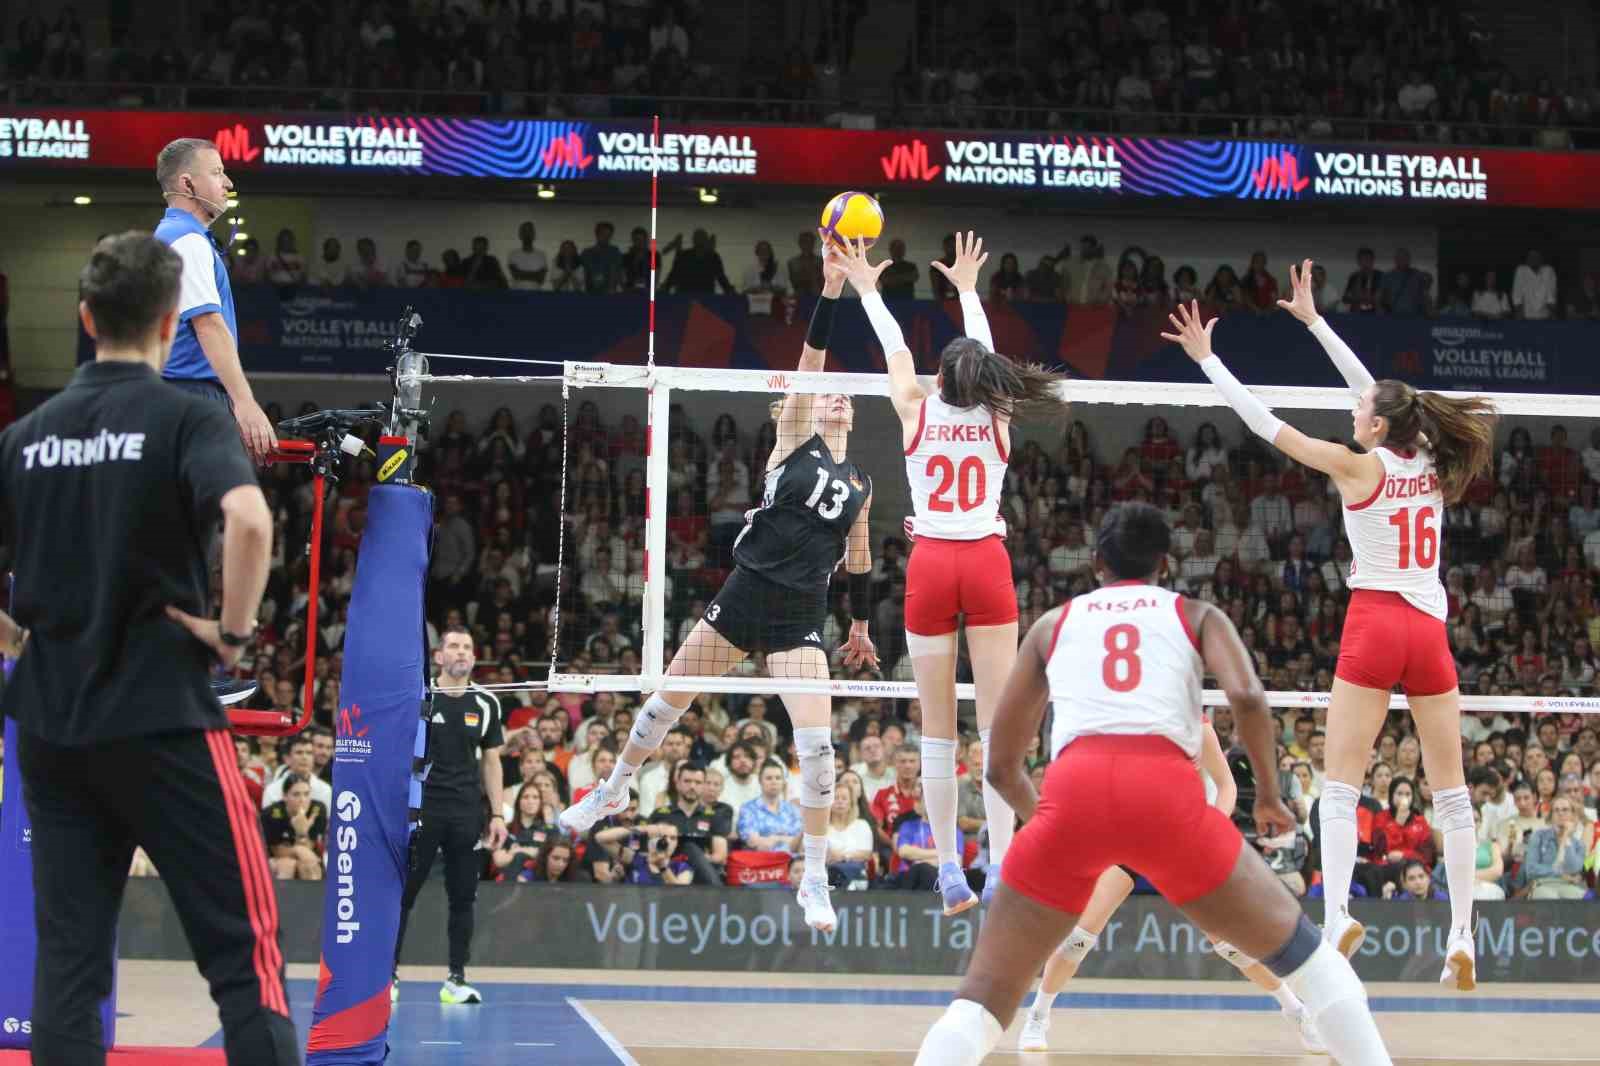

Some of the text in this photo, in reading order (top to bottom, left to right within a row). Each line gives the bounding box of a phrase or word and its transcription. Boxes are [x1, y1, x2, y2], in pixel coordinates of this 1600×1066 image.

[264, 124, 423, 149] VOLLEYBALL
[598, 132, 757, 157] VOLLEYBALL
[17, 142, 90, 159] LEAGUE
[264, 148, 423, 166] NATIONS LEAGUE
[881, 139, 941, 181] VNL
[945, 141, 1121, 168] VOLLEYBALL
[598, 156, 757, 174] NATIONS LEAGUE
[945, 166, 1121, 188] NATIONS LEAGUE
[1252, 151, 1309, 192] VNL
[1315, 152, 1487, 180] VOLLEYBALL
[1315, 177, 1487, 200] NATIONS LEAGUE
[281, 336, 342, 347] NATIONS
[1434, 349, 1546, 367] VOLLEYBALL
[1433, 365, 1546, 380] NATIONS LEAGUE
[925, 424, 992, 442] ERKEK
[22, 428, 146, 470] TÜRKİYE
[805, 467, 850, 519] 13
[925, 455, 987, 513] 20
[1389, 506, 1437, 570] 16
[706, 604, 721, 621] 3
[1102, 623, 1142, 693] 8
[336, 826, 360, 944] Senoh
[586, 902, 792, 955] Voleybol
[811, 903, 908, 949] Milli
